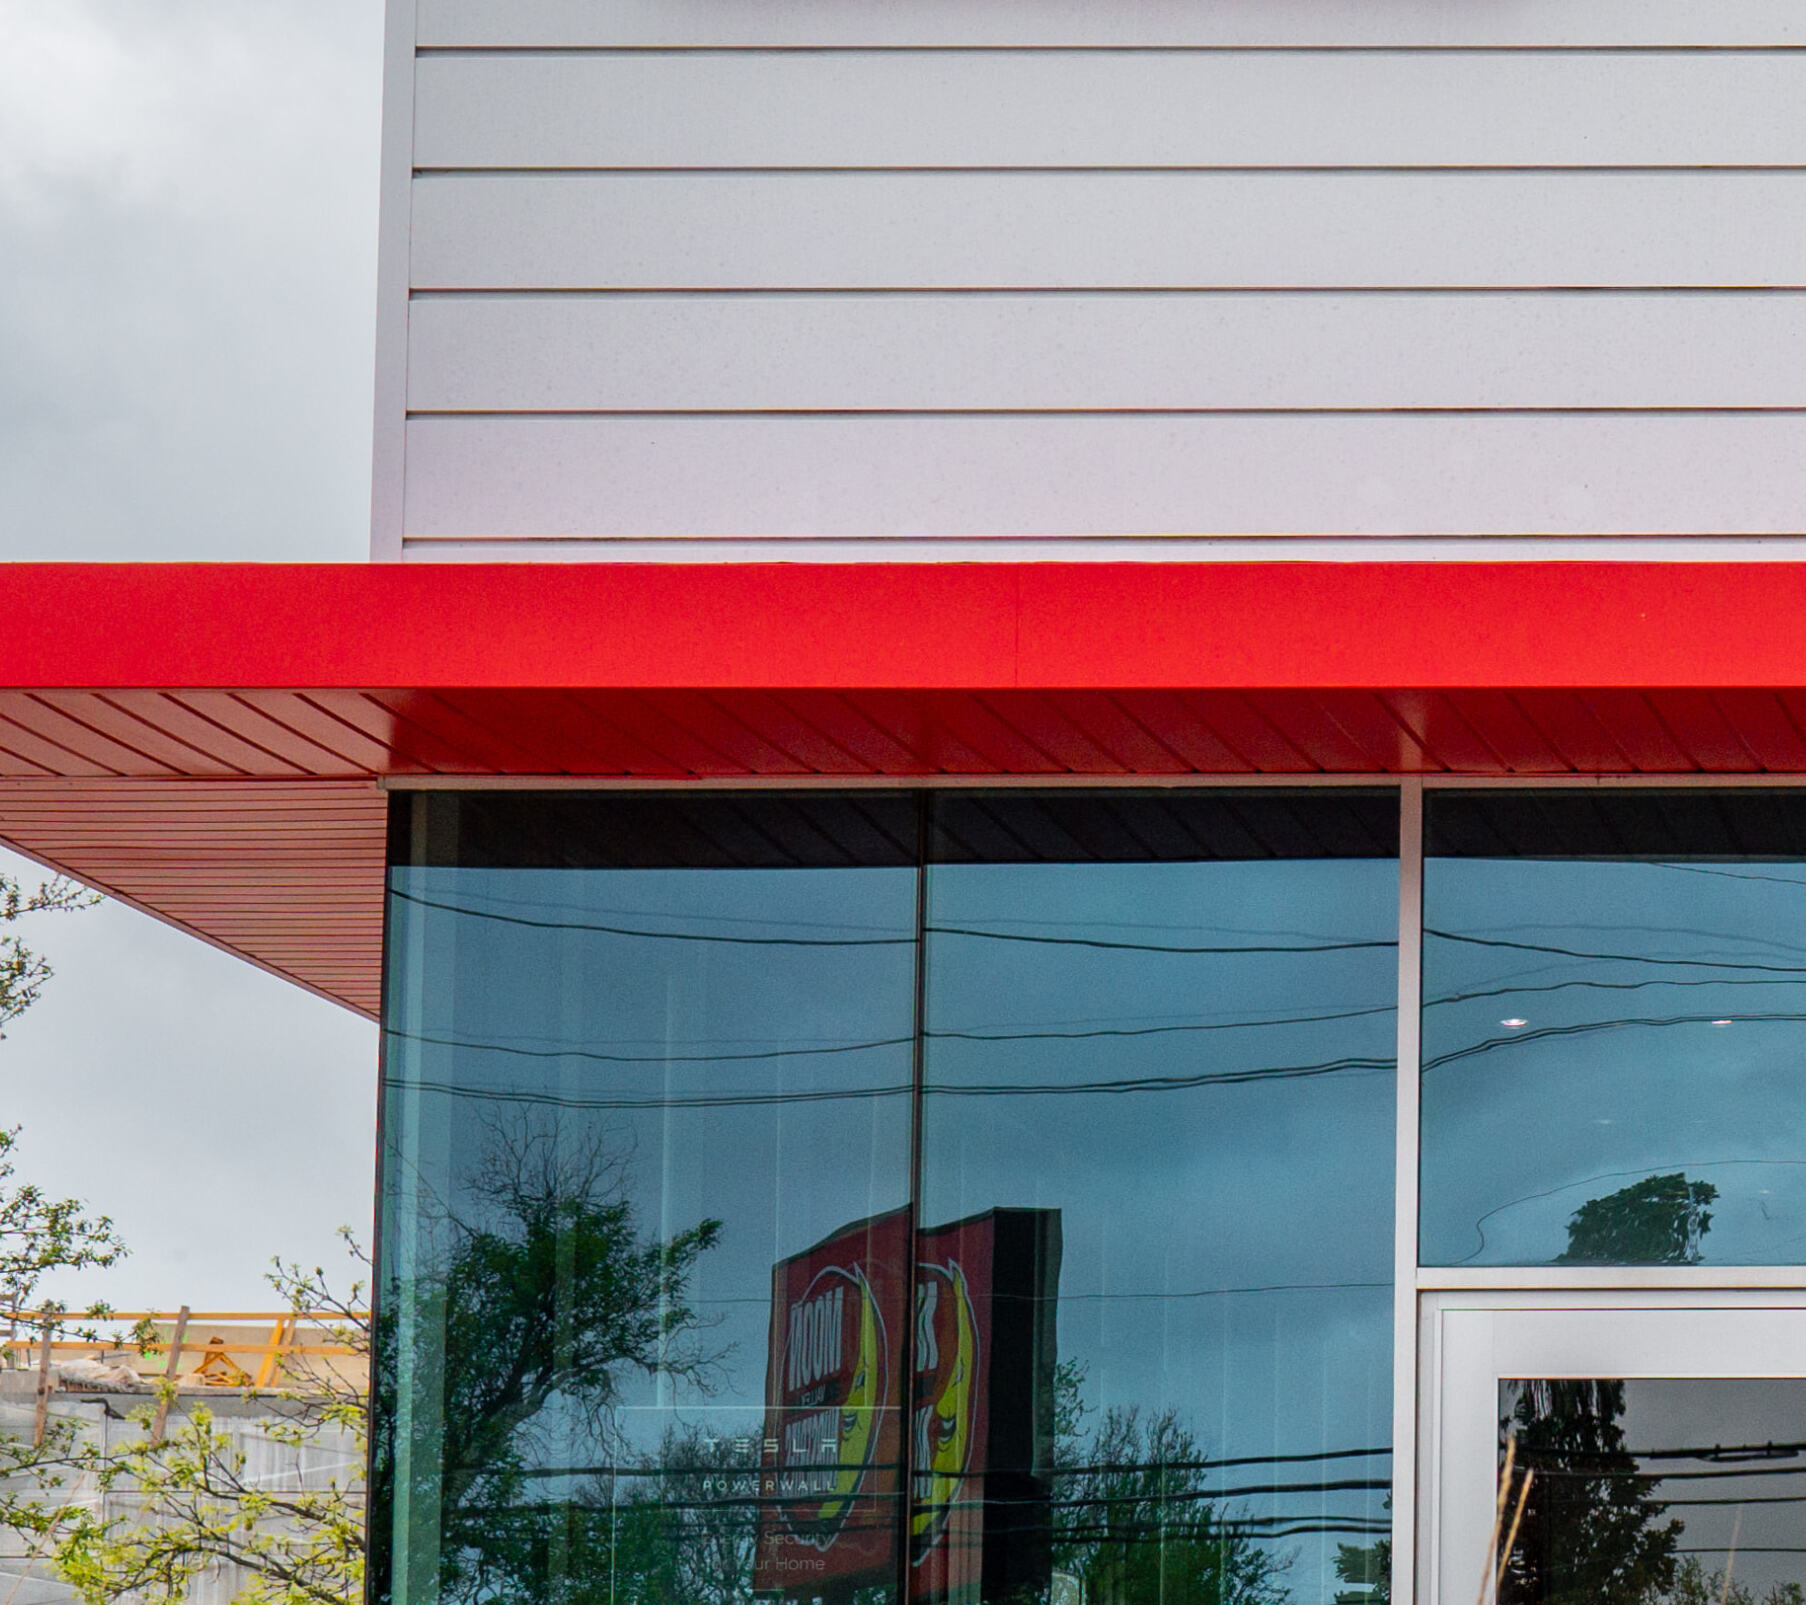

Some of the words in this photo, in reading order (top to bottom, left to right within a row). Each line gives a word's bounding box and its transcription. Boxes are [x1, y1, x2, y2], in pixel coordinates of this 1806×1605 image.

[703, 1438, 837, 1453] TESLA
[702, 1479, 835, 1492] POWERWALL
[763, 1529, 832, 1549] Security
[775, 1556, 826, 1571] Home
